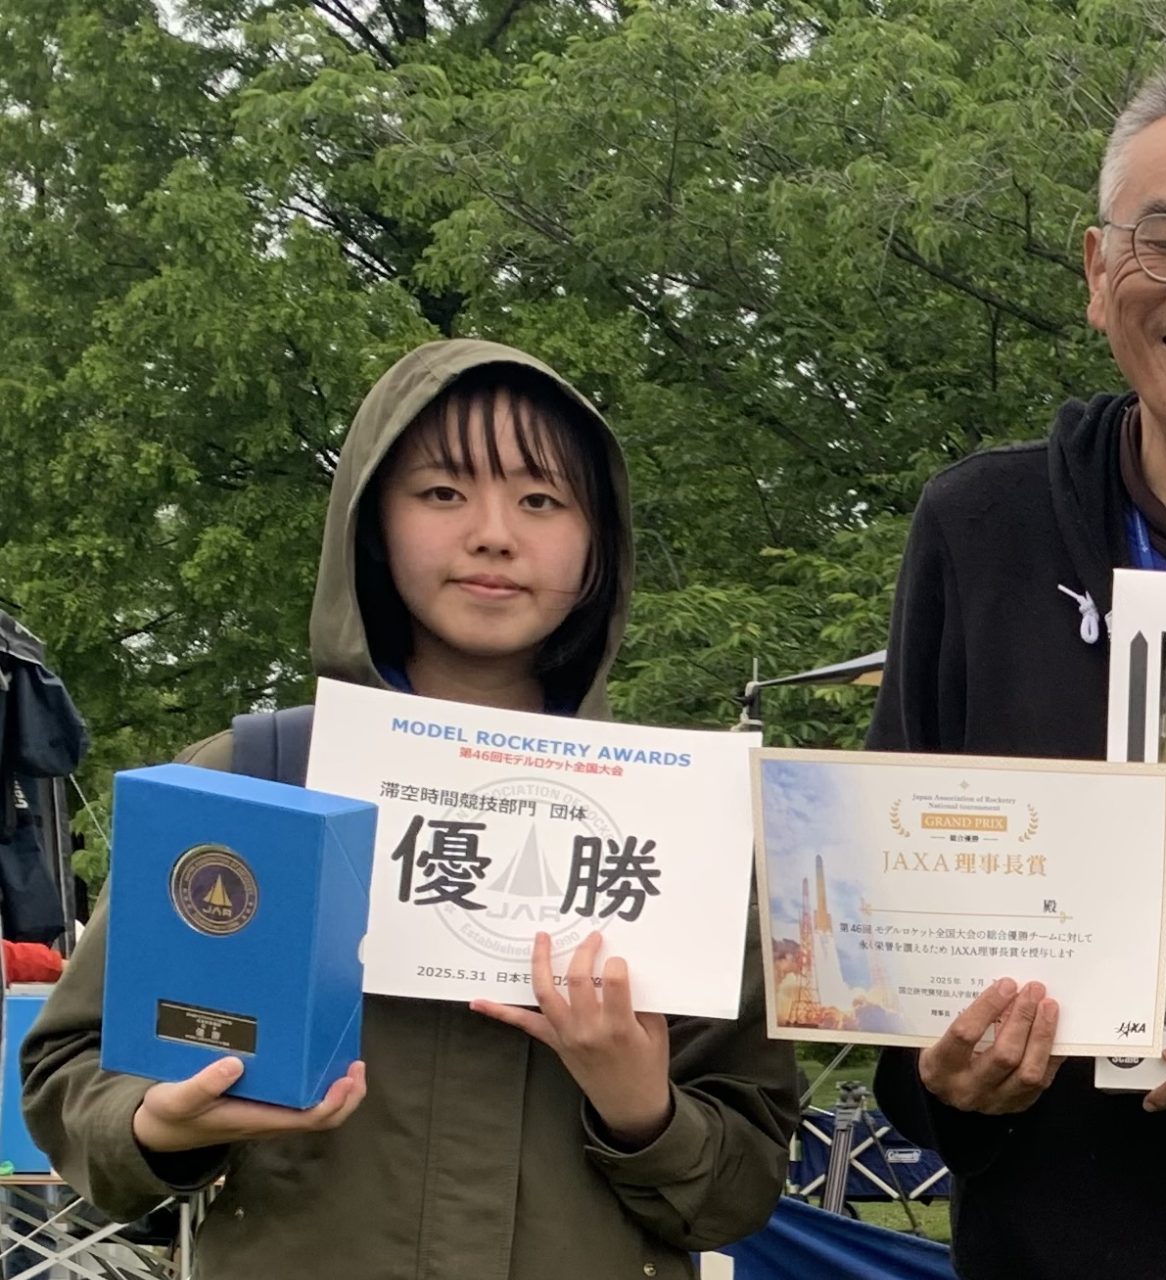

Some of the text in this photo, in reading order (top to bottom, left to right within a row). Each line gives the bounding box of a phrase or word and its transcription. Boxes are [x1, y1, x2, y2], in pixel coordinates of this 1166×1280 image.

[391, 717, 692, 767] MODEL ROCKETRY AWARDS
[459, 747, 624, 776] 第46回モデルロケット全国大会
[380, 781, 537, 817] 滞空時間競技部門
[550, 803, 588, 822] 団体
[912, 793, 932, 803] Japan
[935, 793, 974, 803] Association
[985, 796, 1016, 805] Rocketry
[924, 815, 1005, 830] GRAND PRIX
[1043, 899, 1057, 913] 殿
[416, 966, 487, 982] 2025.5.31
[1114, 1020, 1147, 1040] JAXA
